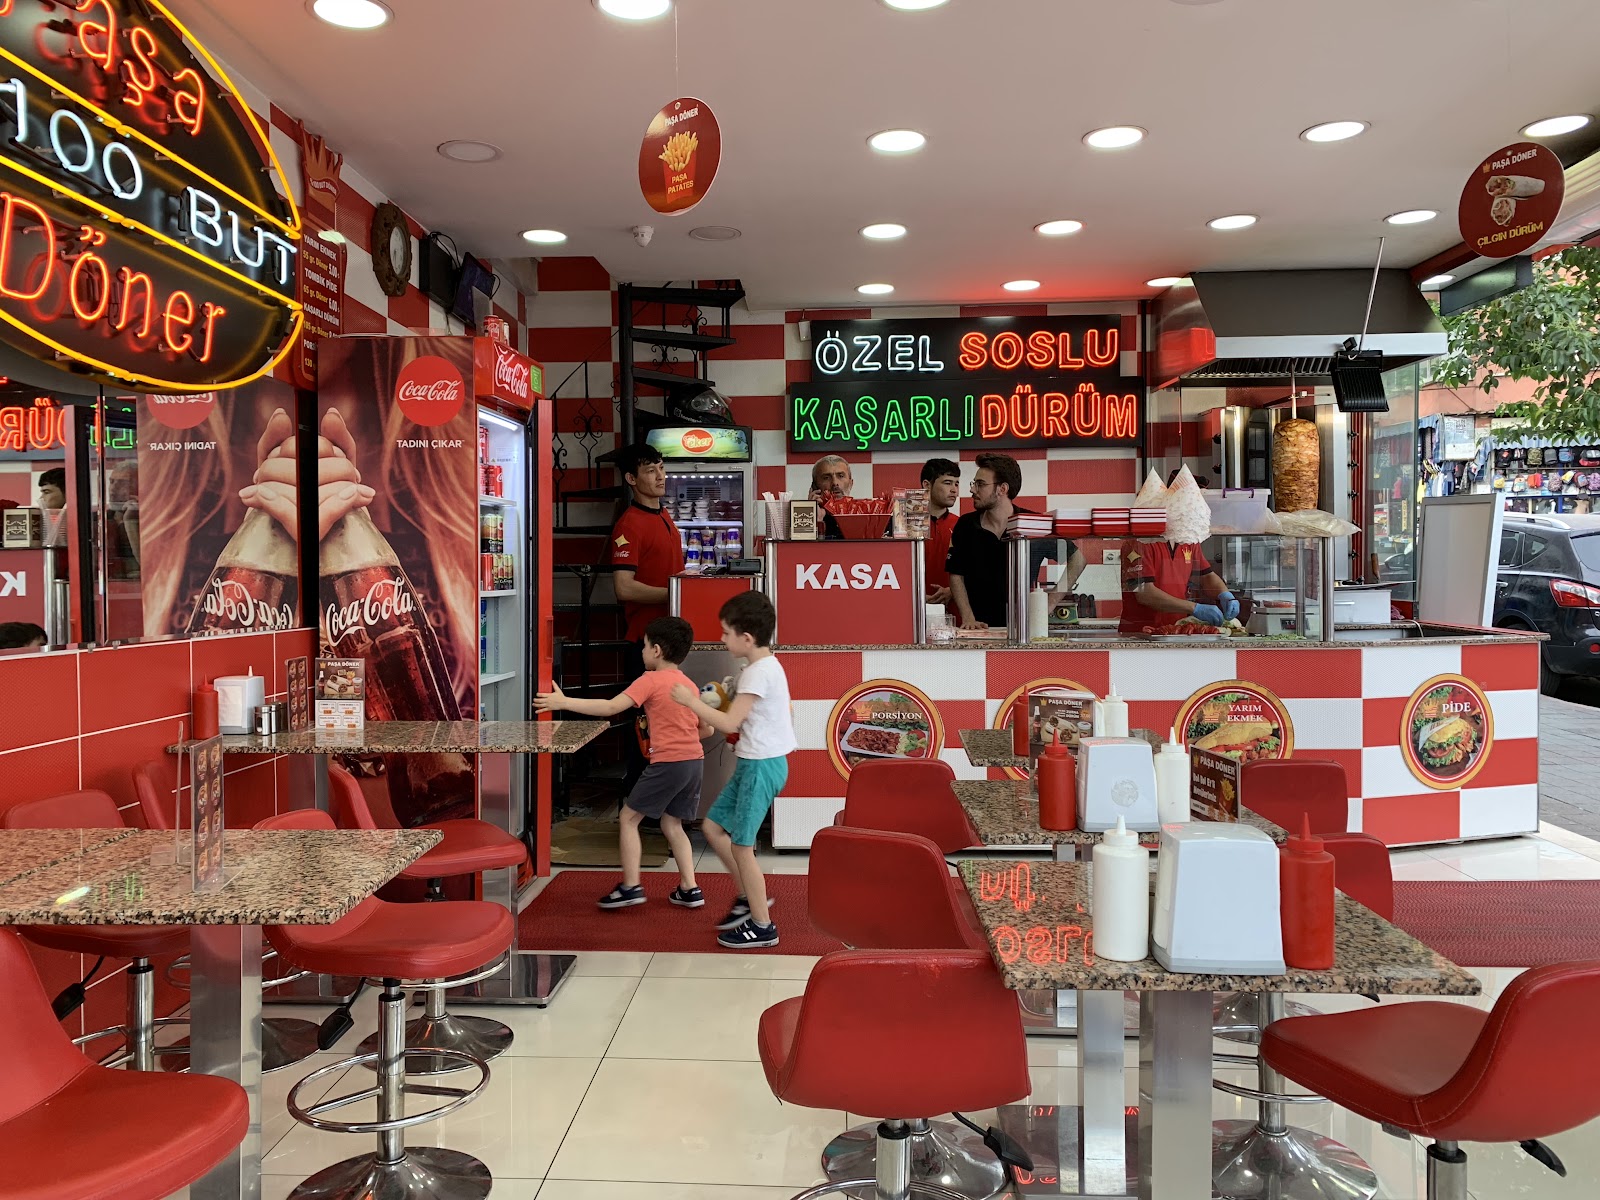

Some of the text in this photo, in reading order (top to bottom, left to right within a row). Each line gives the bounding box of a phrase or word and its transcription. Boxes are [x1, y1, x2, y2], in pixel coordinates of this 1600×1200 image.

[664, 107, 699, 126] PAŞA DÖNER
[1492, 148, 1538, 170] PAŞA DÖNER
[667, 180, 694, 195] PATATES
[671, 172, 688, 184] PAŞA
[187, 186, 297, 285] BUT
[1477, 221, 1544, 248] ÇILGIN DÜRÜM
[0, 192, 226, 362] Döner
[815, 328, 1119, 374] ÖZEL SOSLU
[399, 379, 462, 401] Coca-Cola
[794, 382, 1137, 450] KAŞARLI DÜRÜM
[396, 439, 463, 450] TADINI ÇIKAR
[795, 563, 901, 591] KASA
[326, 576, 417, 647] Coca-Cola
[1048, 698, 1063, 706] PAŞA
[1228, 704, 1262, 712] YARIM
[1441, 701, 1472, 714] PİDE
[871, 710, 923, 720] PORSİYON
[1227, 714, 1264, 722] EKMEK
[1199, 755, 1236, 776] PAŞA DÖNER
